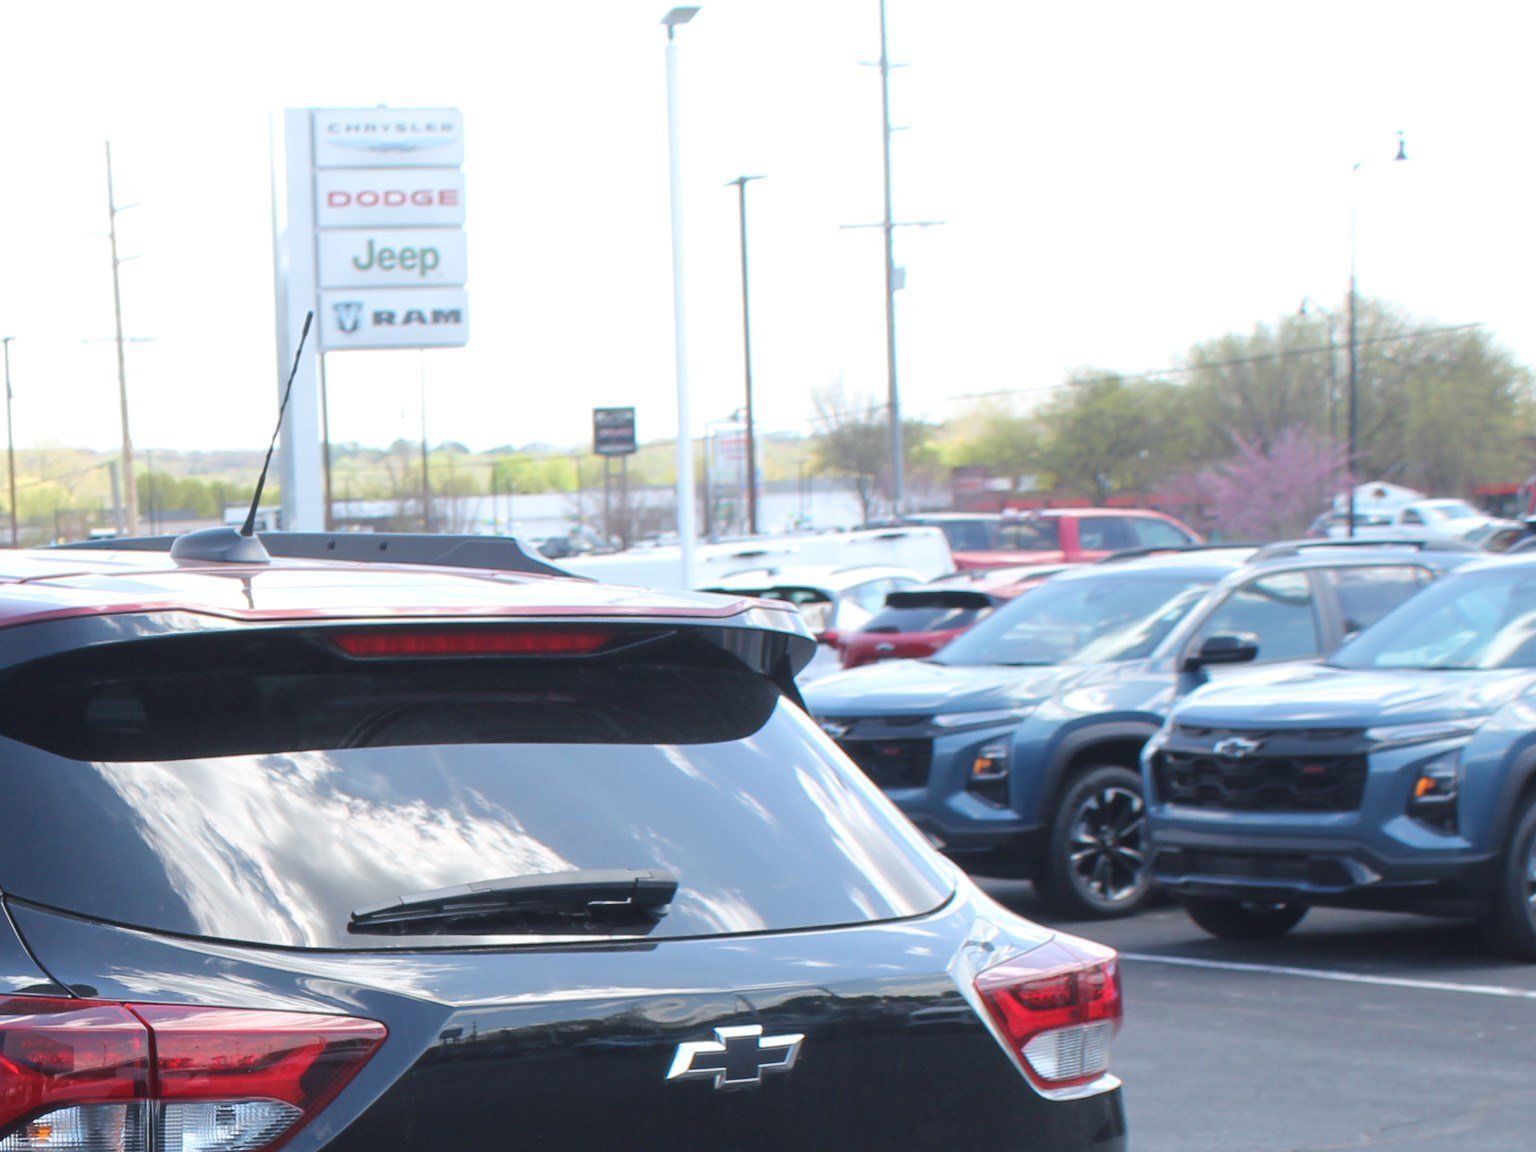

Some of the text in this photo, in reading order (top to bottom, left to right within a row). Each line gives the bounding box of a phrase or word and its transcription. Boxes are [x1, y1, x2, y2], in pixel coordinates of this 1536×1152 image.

[326, 122, 454, 135] CHRYSLER
[327, 189, 459, 208] DODGE
[352, 238, 440, 277] Jeep
[371, 308, 463, 327] RAM
